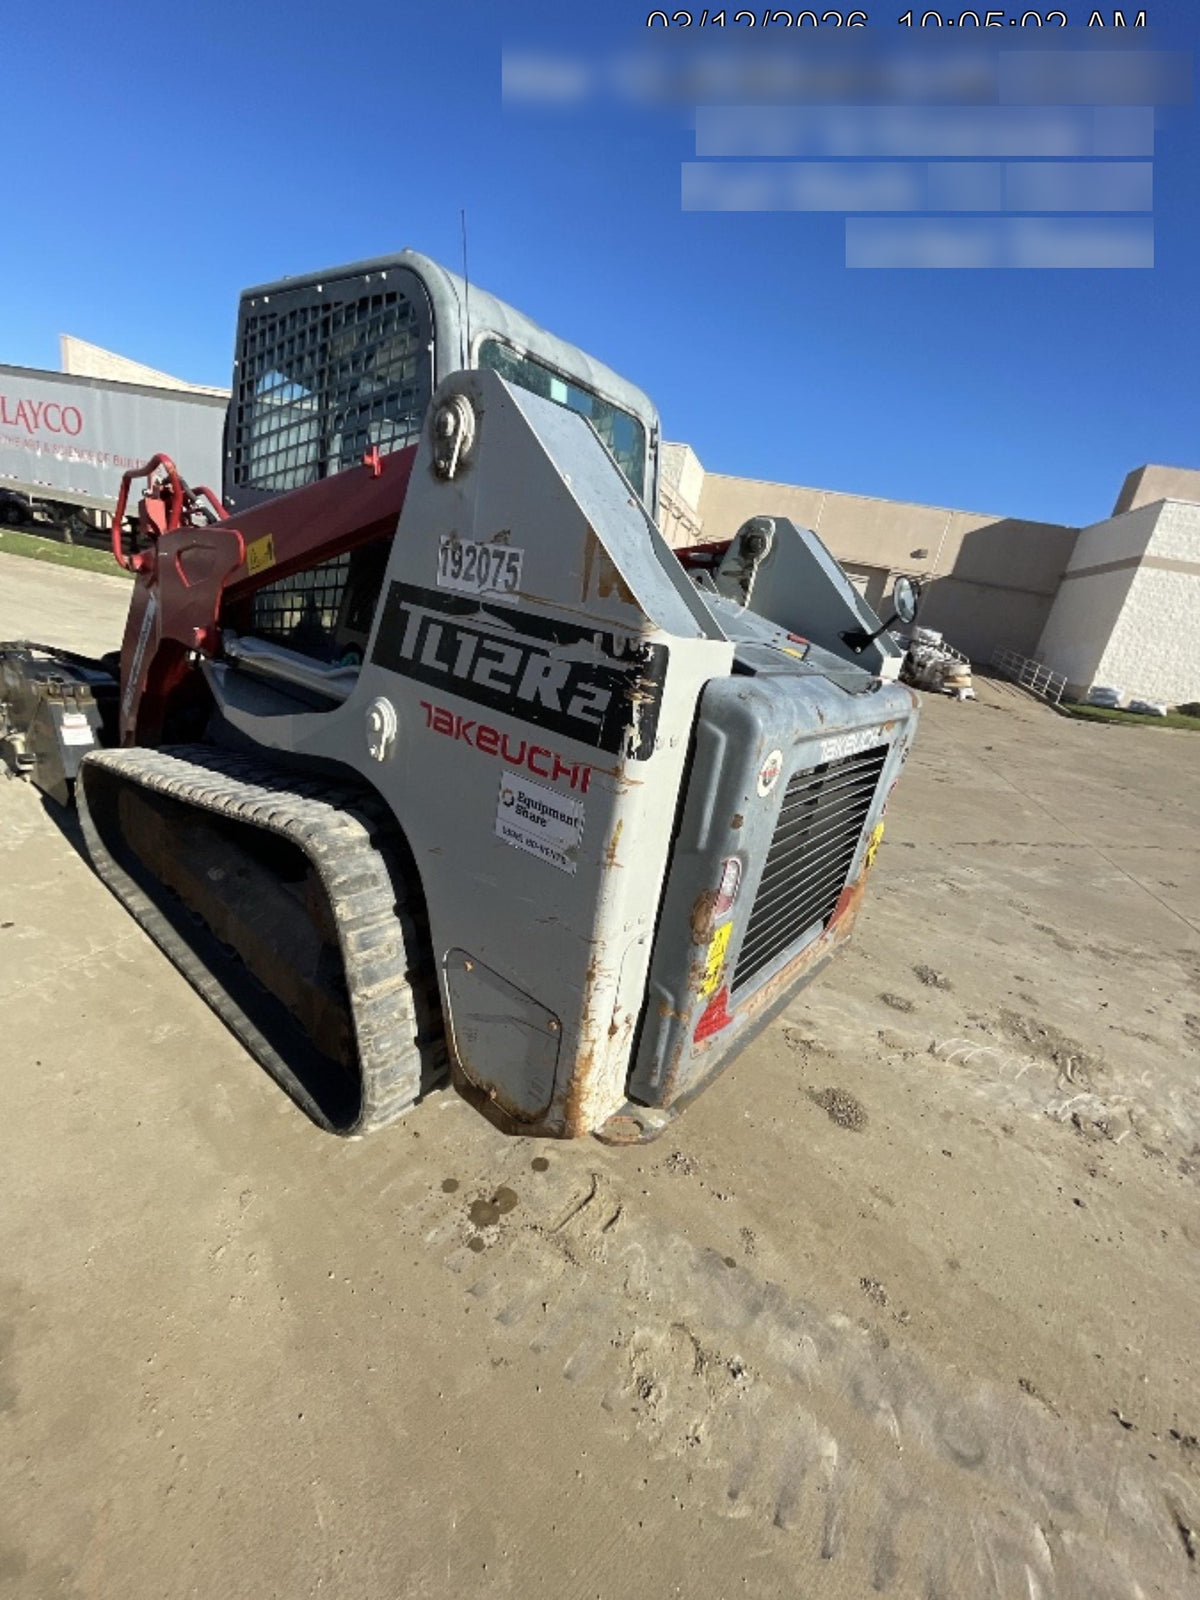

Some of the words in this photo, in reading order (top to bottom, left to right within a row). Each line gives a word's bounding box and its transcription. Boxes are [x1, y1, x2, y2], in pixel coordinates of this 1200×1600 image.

[440, 540, 520, 592] 192075
[419, 699, 592, 794] TAKEUCHI
[514, 803, 548, 828] Share
[516, 790, 579, 828] Equipment
